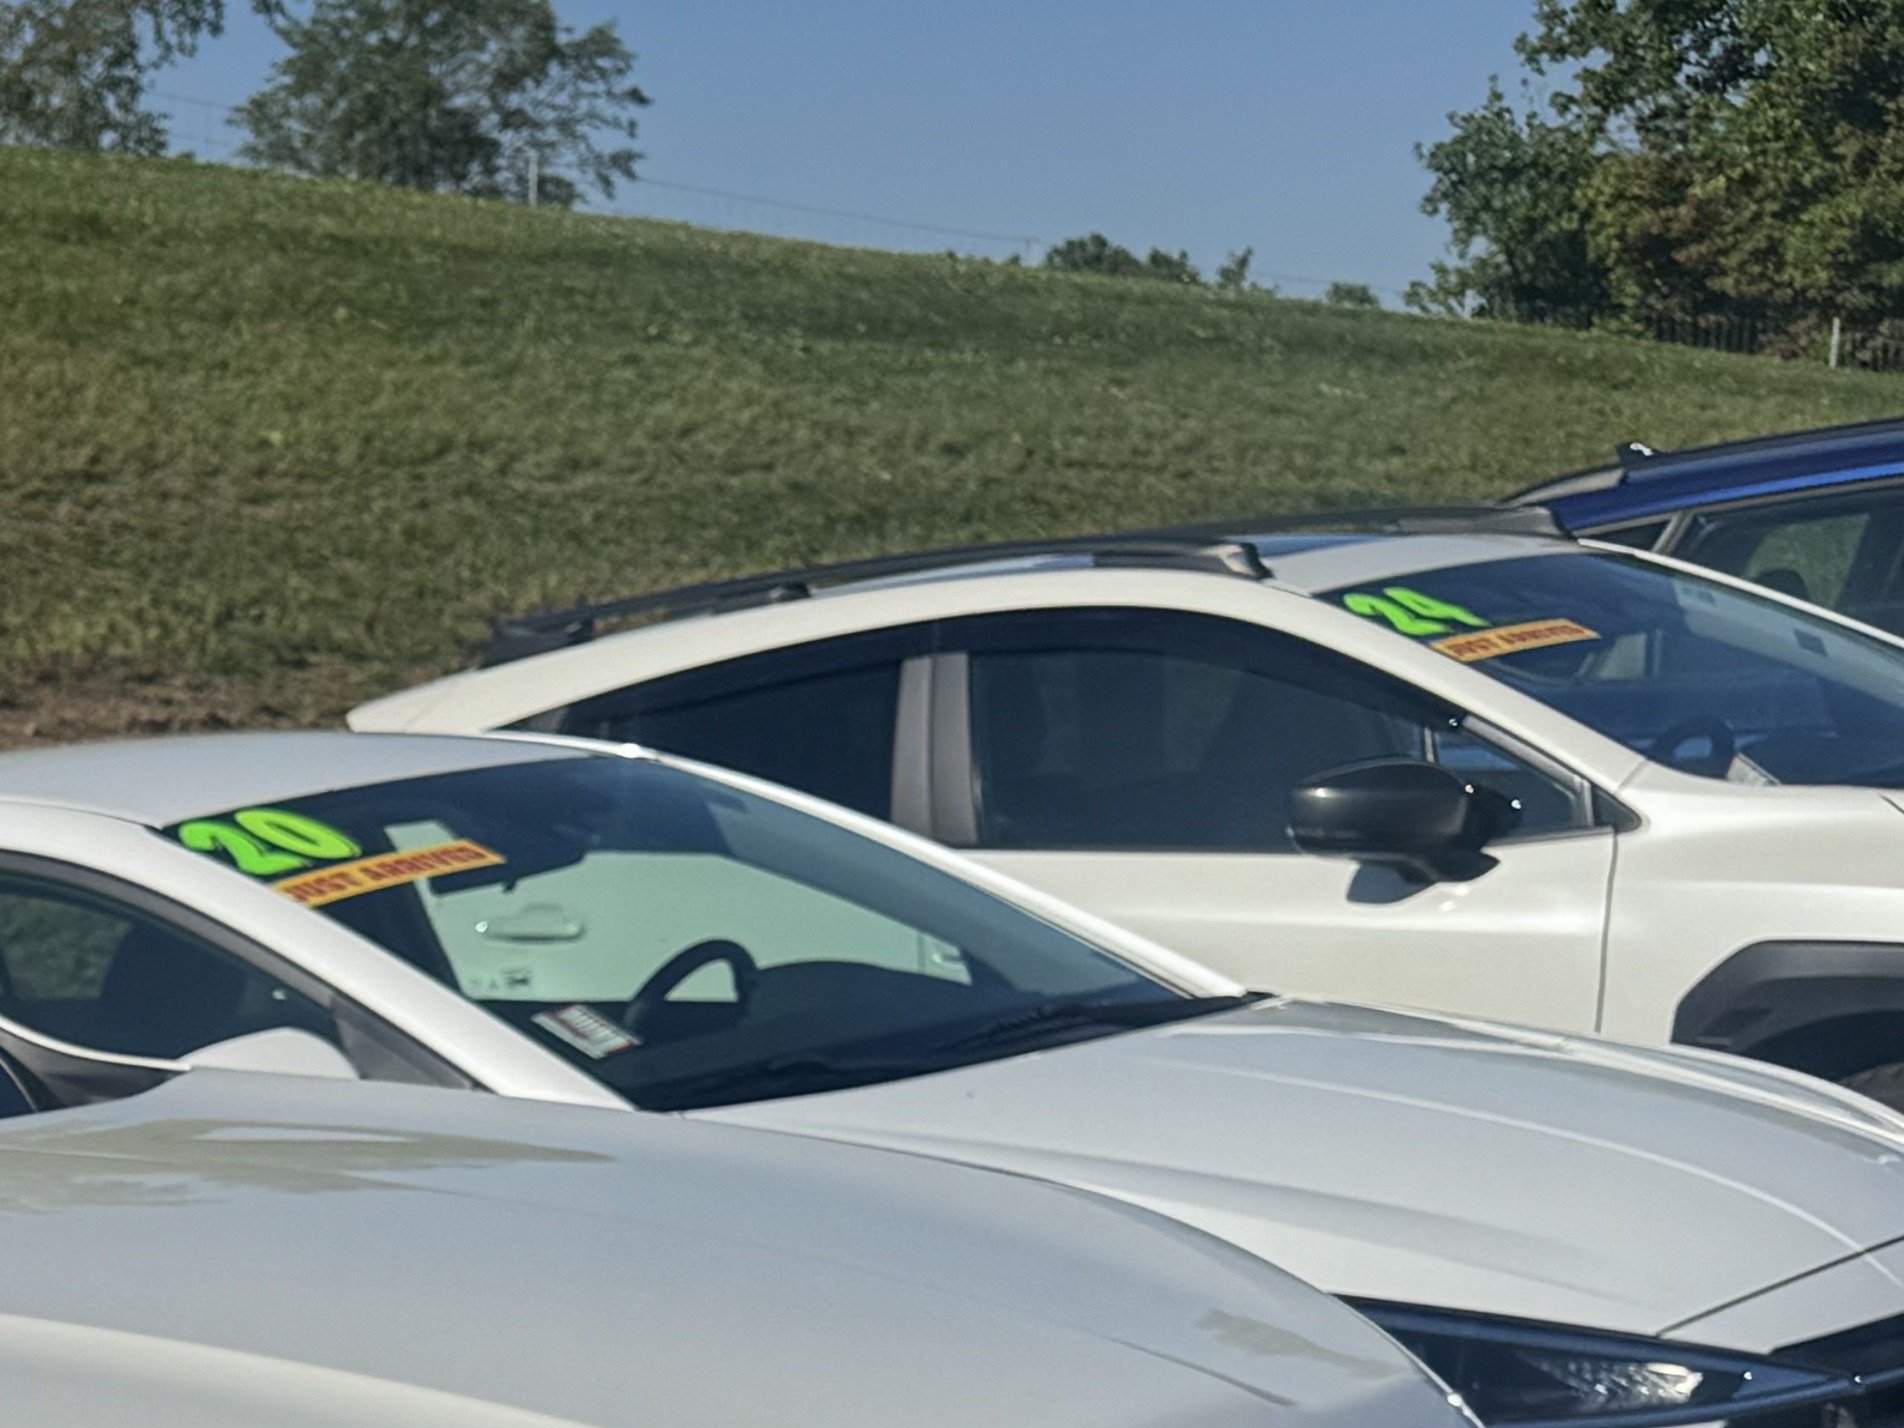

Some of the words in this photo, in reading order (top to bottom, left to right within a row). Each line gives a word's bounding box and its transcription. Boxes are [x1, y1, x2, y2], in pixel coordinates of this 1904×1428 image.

[1343, 586, 1492, 637] 24
[178, 808, 362, 876] 20
[285, 872, 364, 904] JUST
[360, 845, 490, 882] ARRIVED
